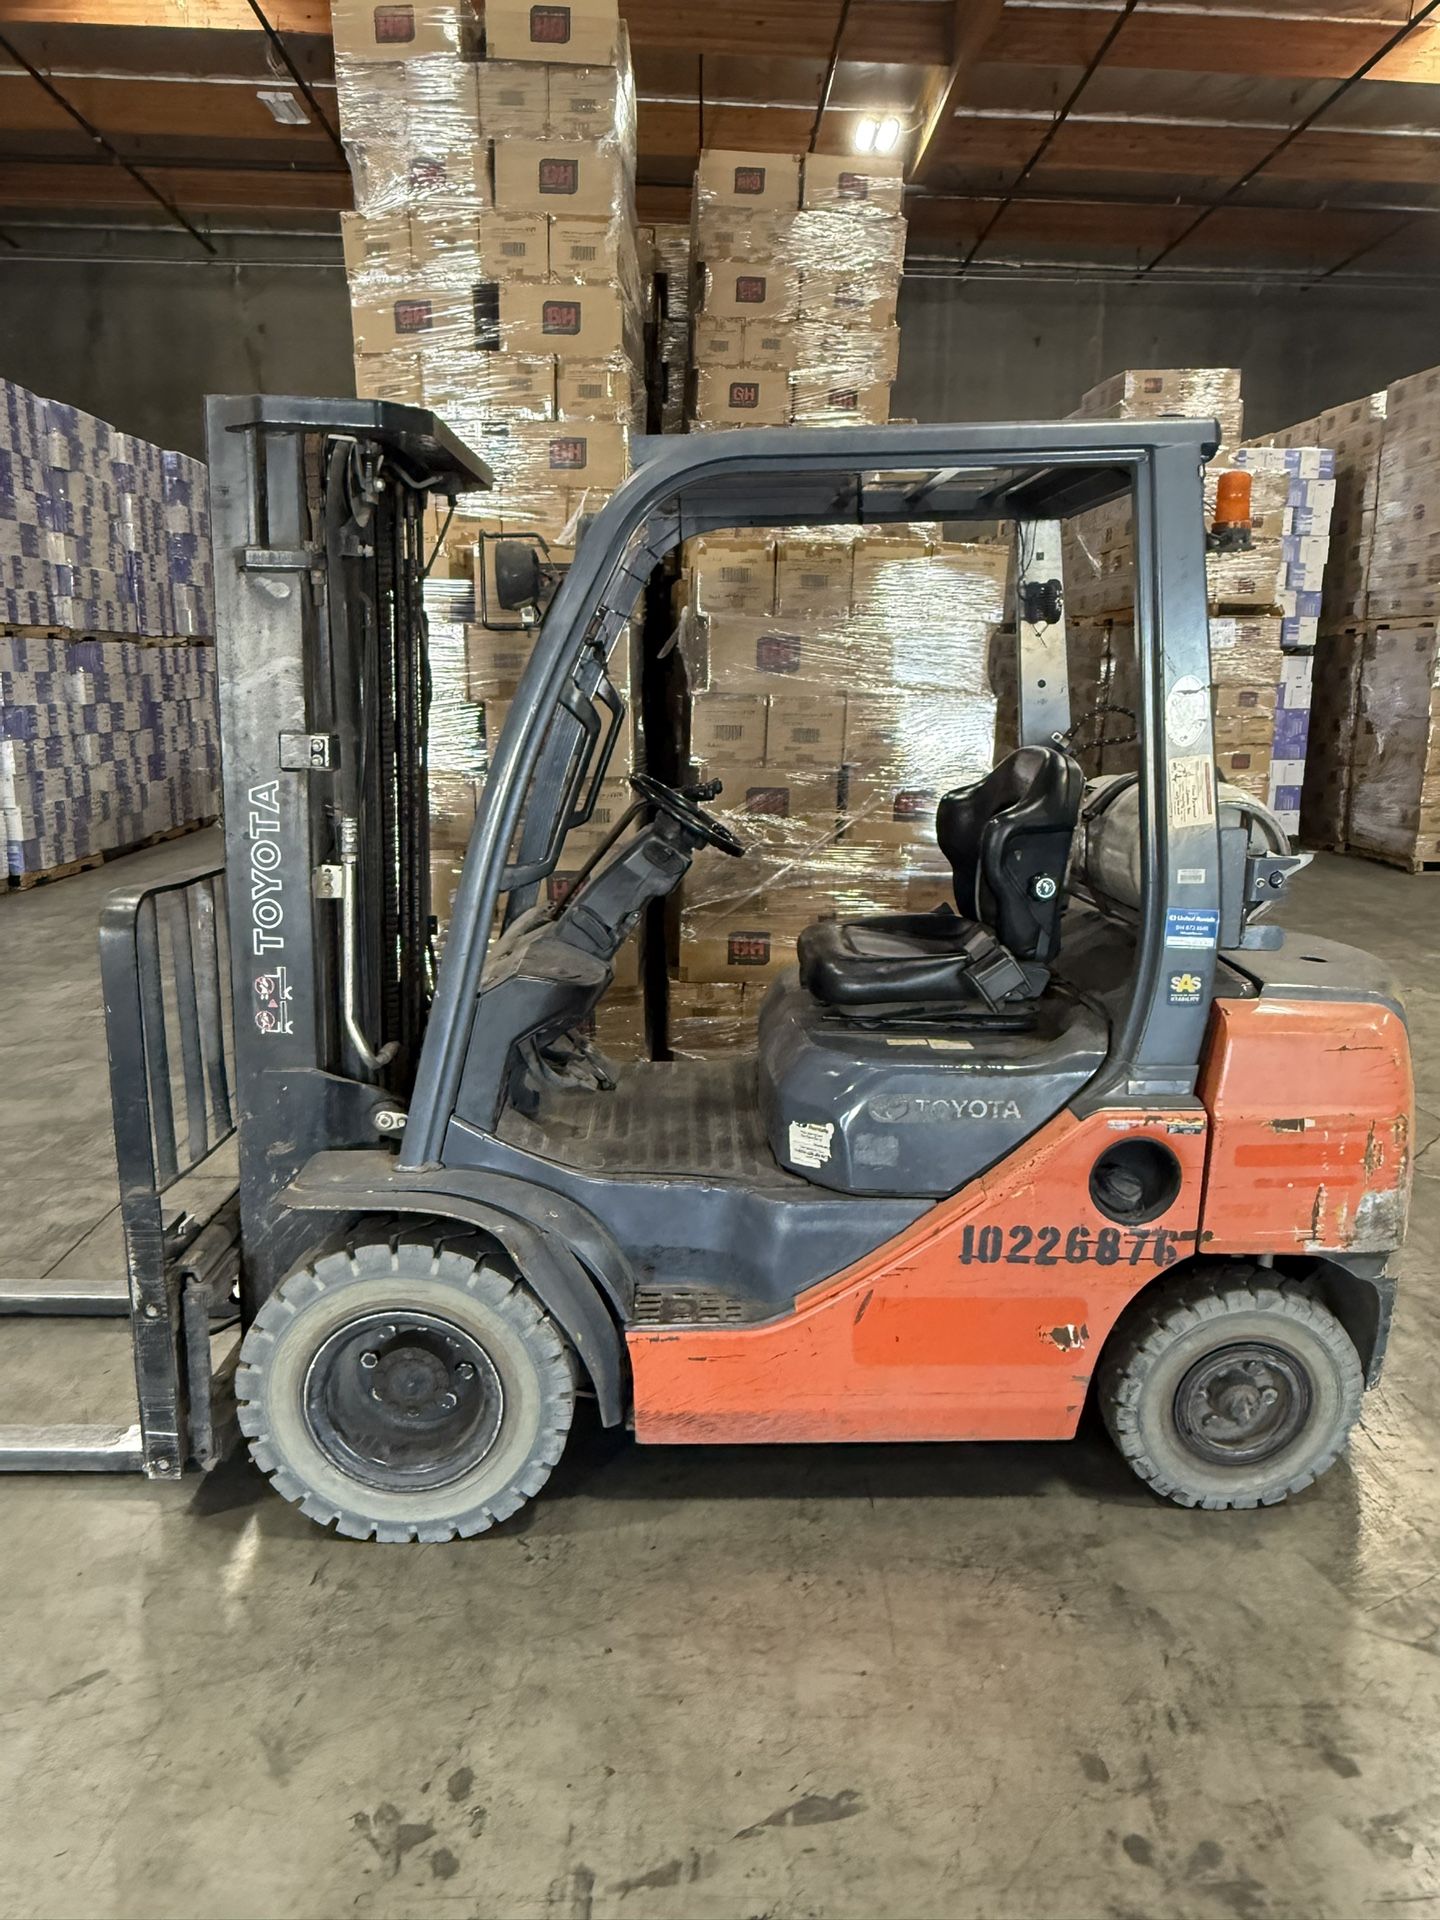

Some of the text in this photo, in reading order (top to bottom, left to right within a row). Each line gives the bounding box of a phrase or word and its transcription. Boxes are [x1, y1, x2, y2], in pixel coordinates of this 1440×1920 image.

[248, 780, 284, 955] TOYOTA
[1170, 973, 1202, 992] SAS
[915, 1099, 1022, 1119] TOYOTA
